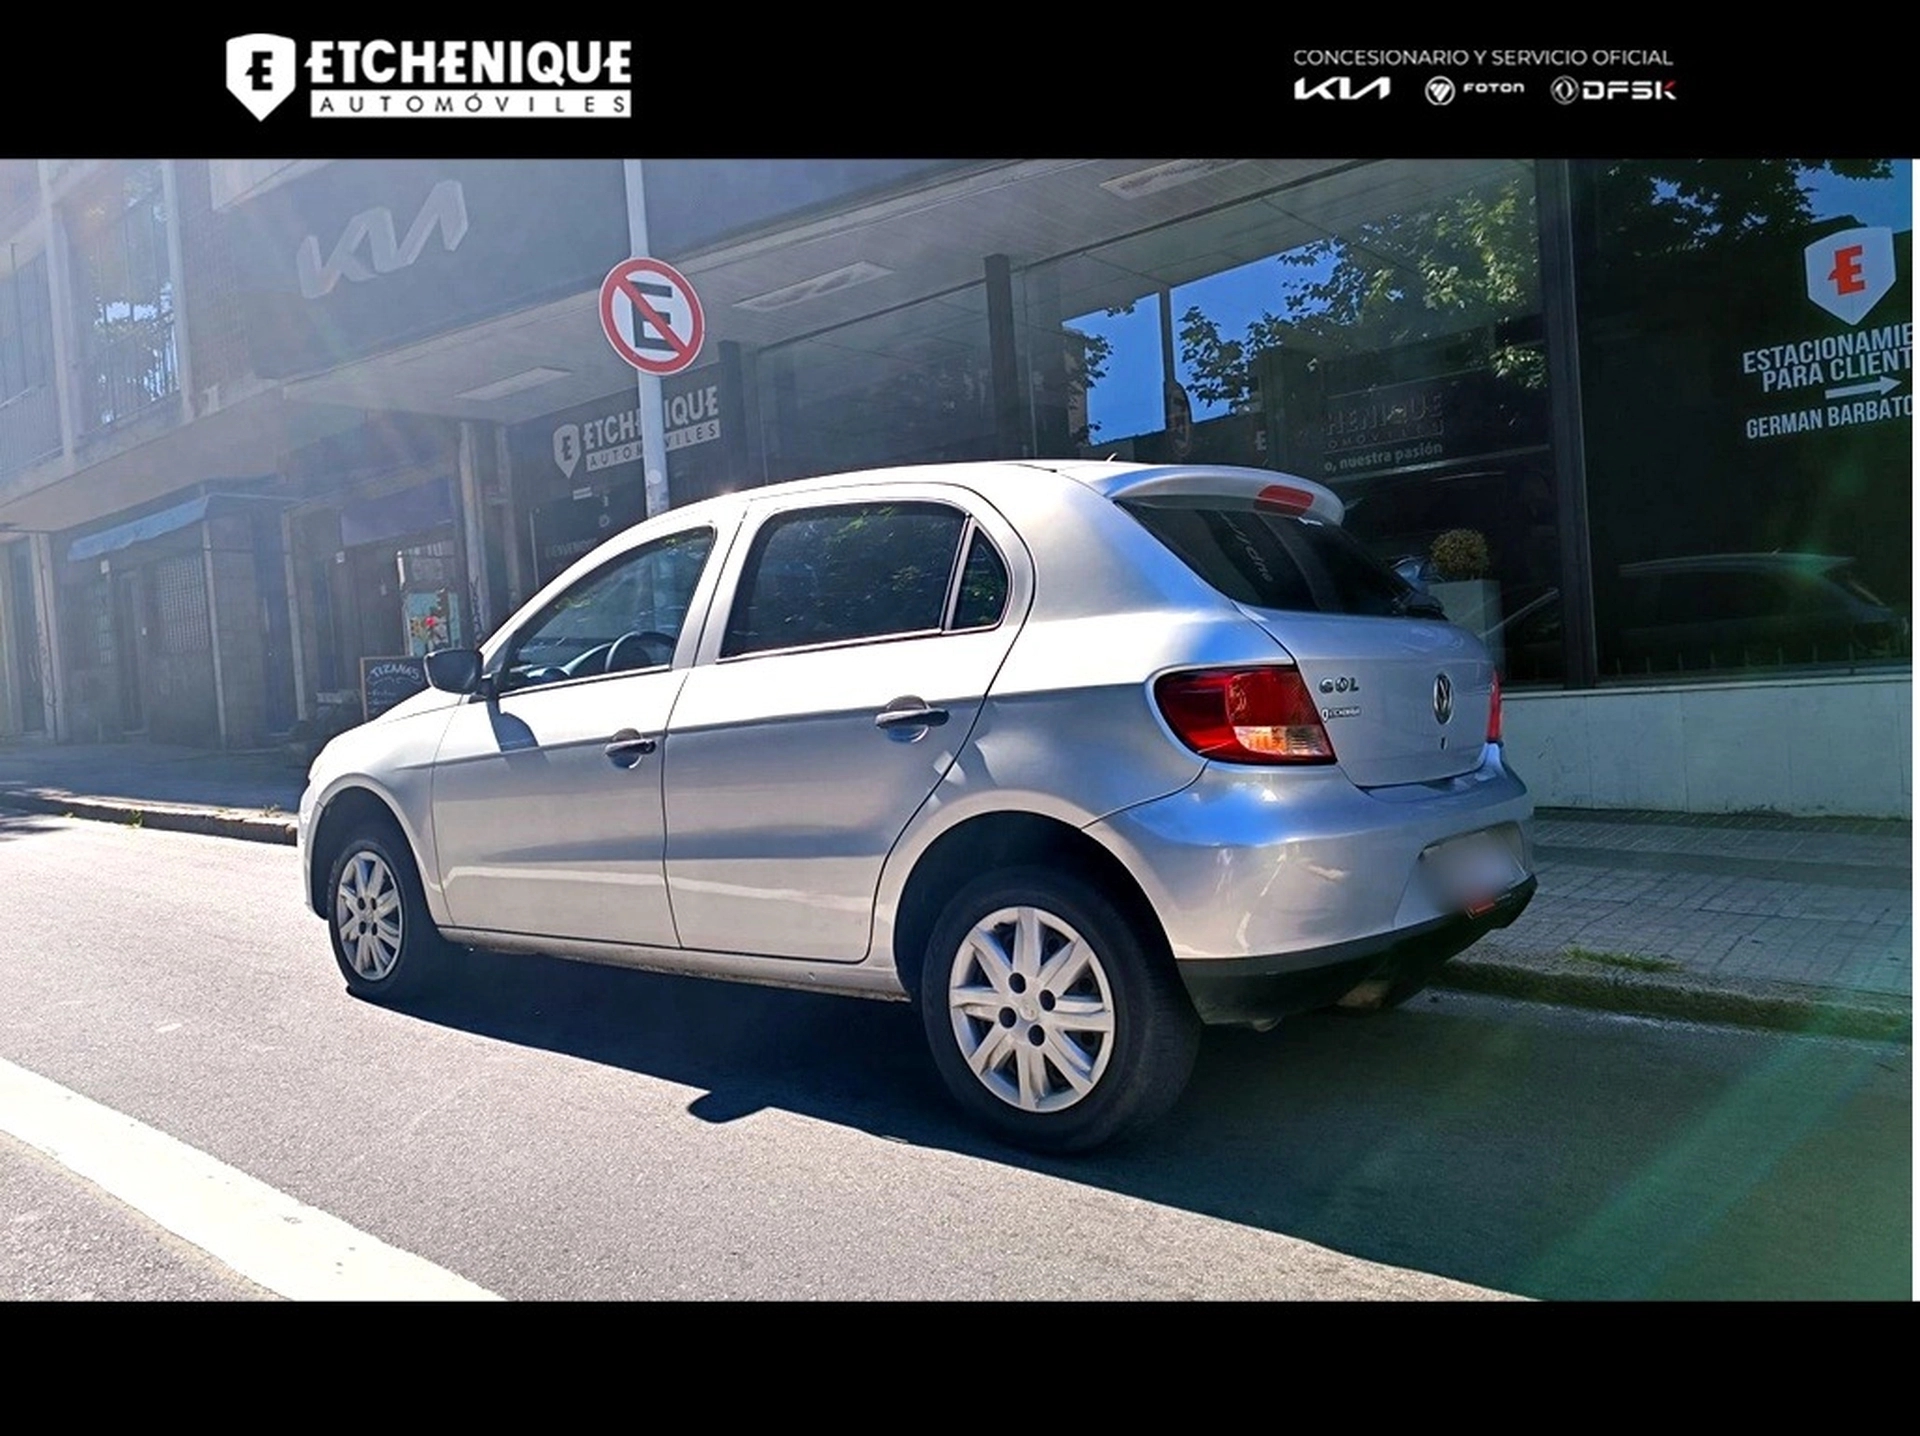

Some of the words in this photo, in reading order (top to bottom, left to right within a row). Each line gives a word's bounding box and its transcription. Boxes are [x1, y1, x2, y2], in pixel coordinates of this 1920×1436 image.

[296, 180, 469, 299] KIA
[1828, 245, 1865, 295] E
[630, 281, 677, 351] E
[1743, 322, 1912, 374] ESTACIONAMIE
[1762, 363, 1824, 392] PARA
[1830, 346, 1912, 381] CLIENT
[583, 386, 720, 450] ETCHIQUE
[1746, 409, 1822, 439] GERMAN
[1340, 449, 1392, 469] nuestra
[1395, 439, 1443, 464] pasión
[1319, 677, 1359, 694] GOL
